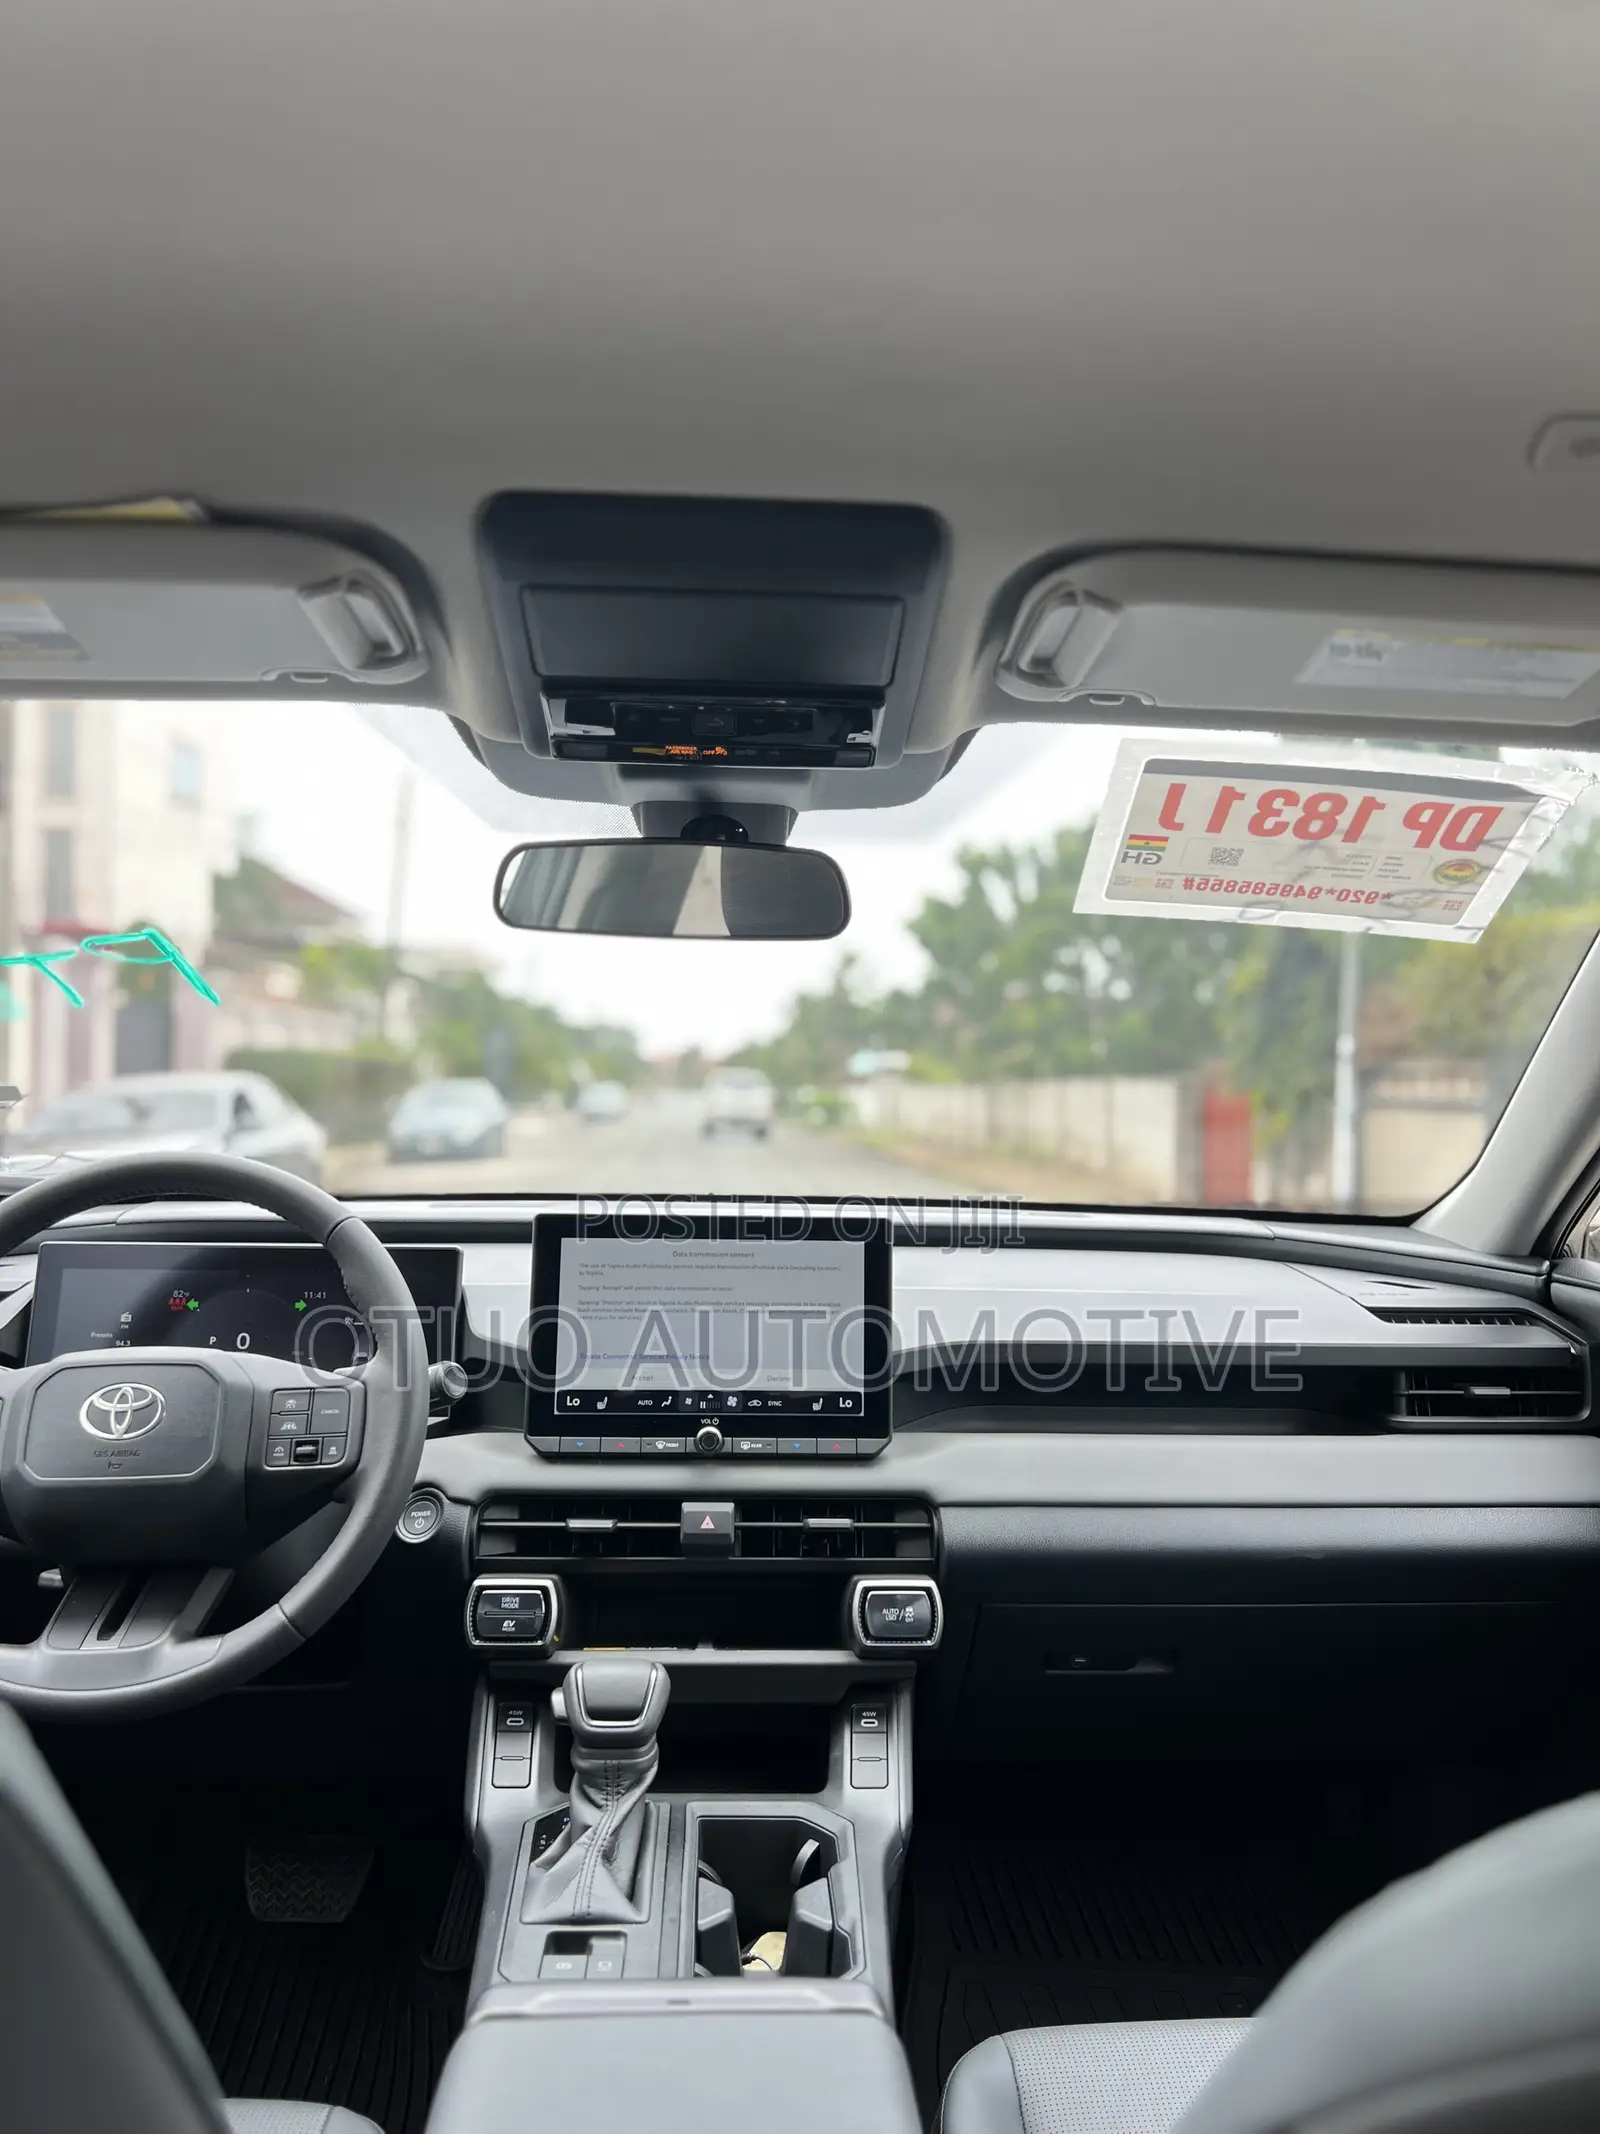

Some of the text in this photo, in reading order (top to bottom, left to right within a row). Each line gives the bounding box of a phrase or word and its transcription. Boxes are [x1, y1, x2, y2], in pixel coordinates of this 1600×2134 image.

[304, 1291, 327, 1299] 11:41
[209, 1336, 216, 1345] P
[236, 1332, 250, 1349] 0
[566, 1396, 580, 1406] Lo
[839, 1397, 853, 1408] Lo
[110, 1449, 140, 1457] AIRBAG
